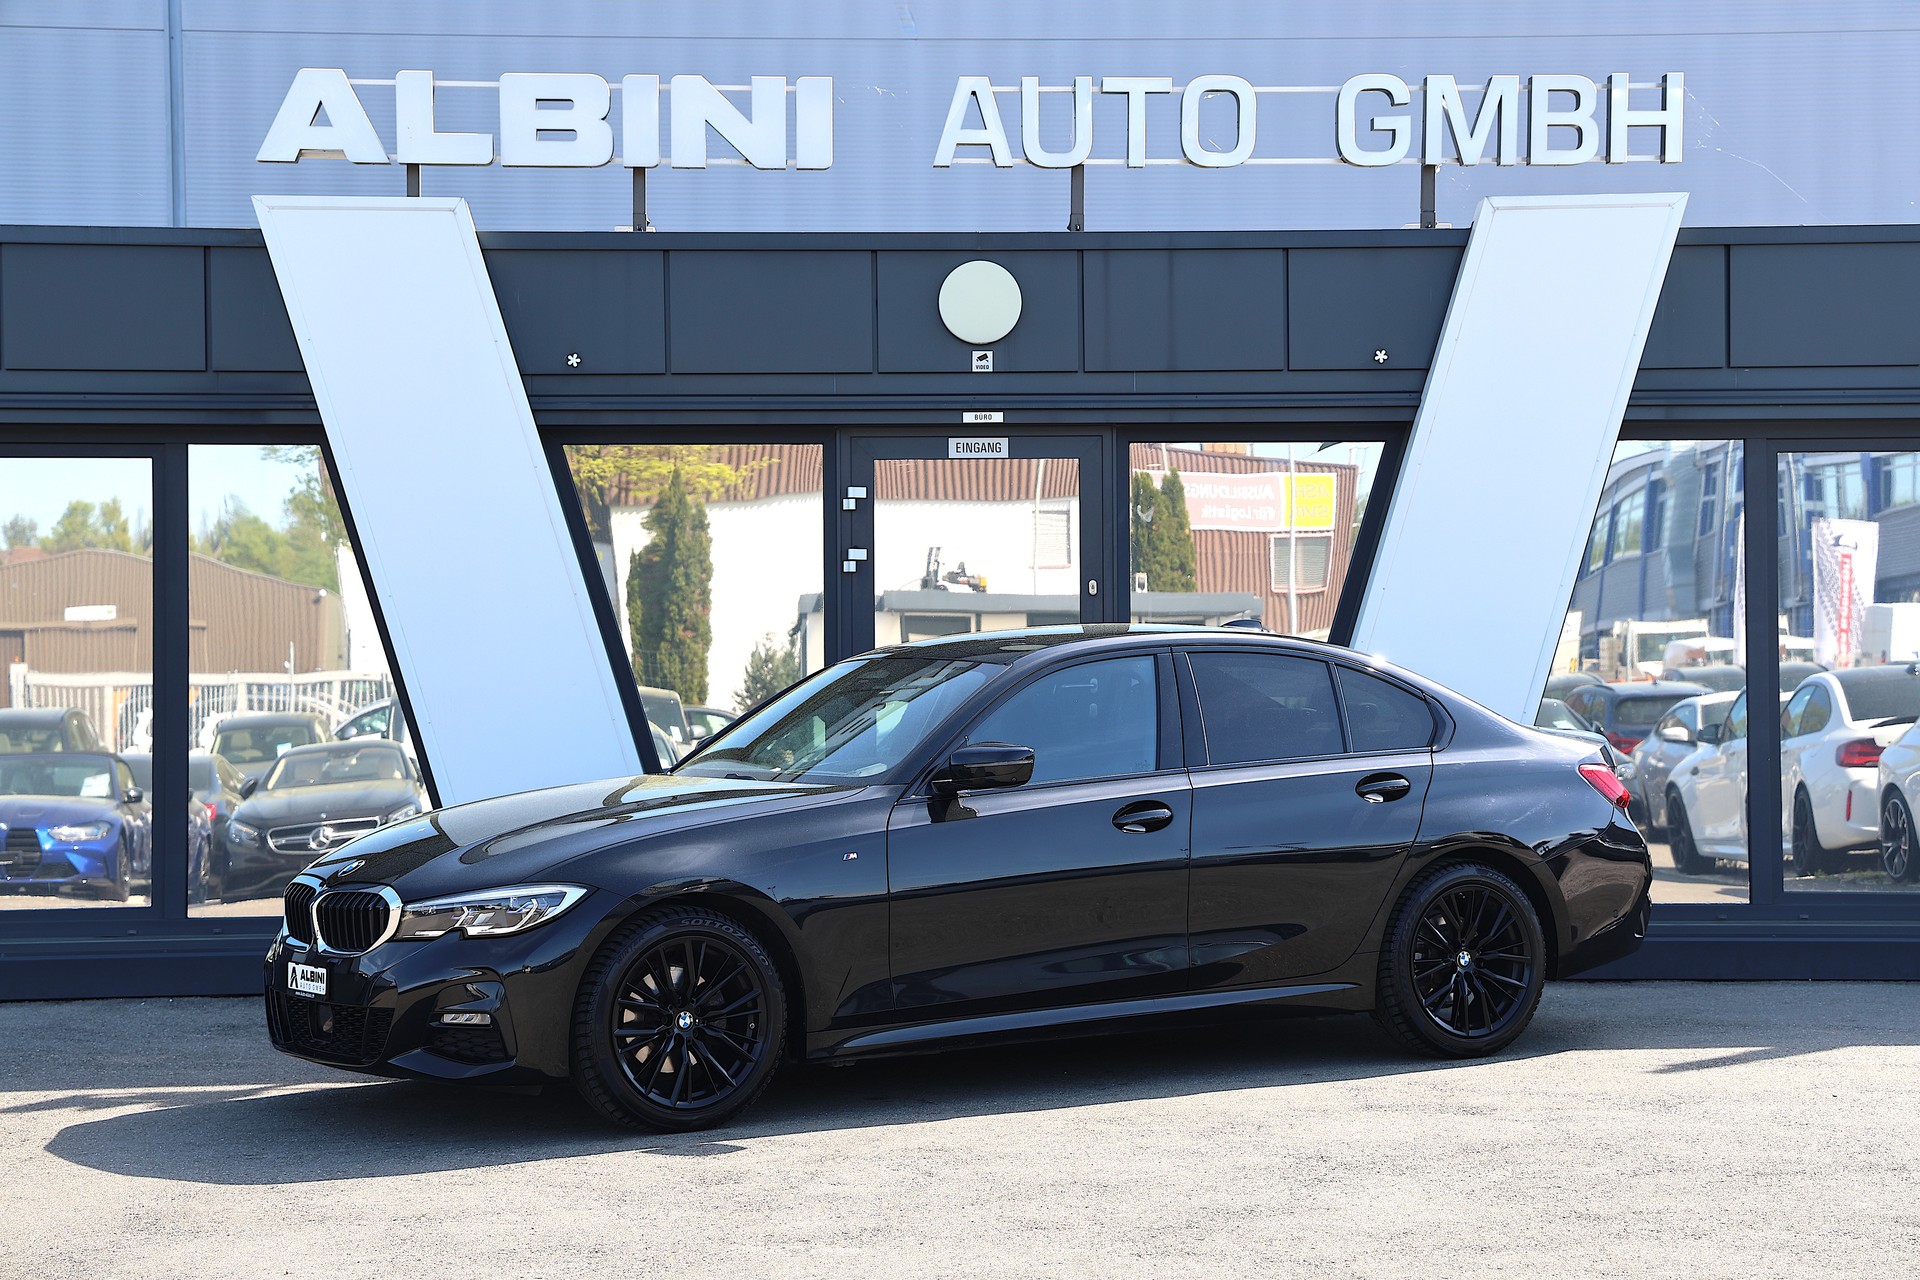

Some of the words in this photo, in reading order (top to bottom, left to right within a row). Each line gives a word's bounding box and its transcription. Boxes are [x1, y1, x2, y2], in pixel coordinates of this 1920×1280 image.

[256, 68, 834, 170] ALBINI
[933, 74, 1257, 169] AUTO
[1335, 72, 1685, 168] GMBH
[955, 442, 1002, 453] EINGANG
[680, 919, 769, 966] SOTTOZERO
[300, 969, 325, 984] ALBINI
